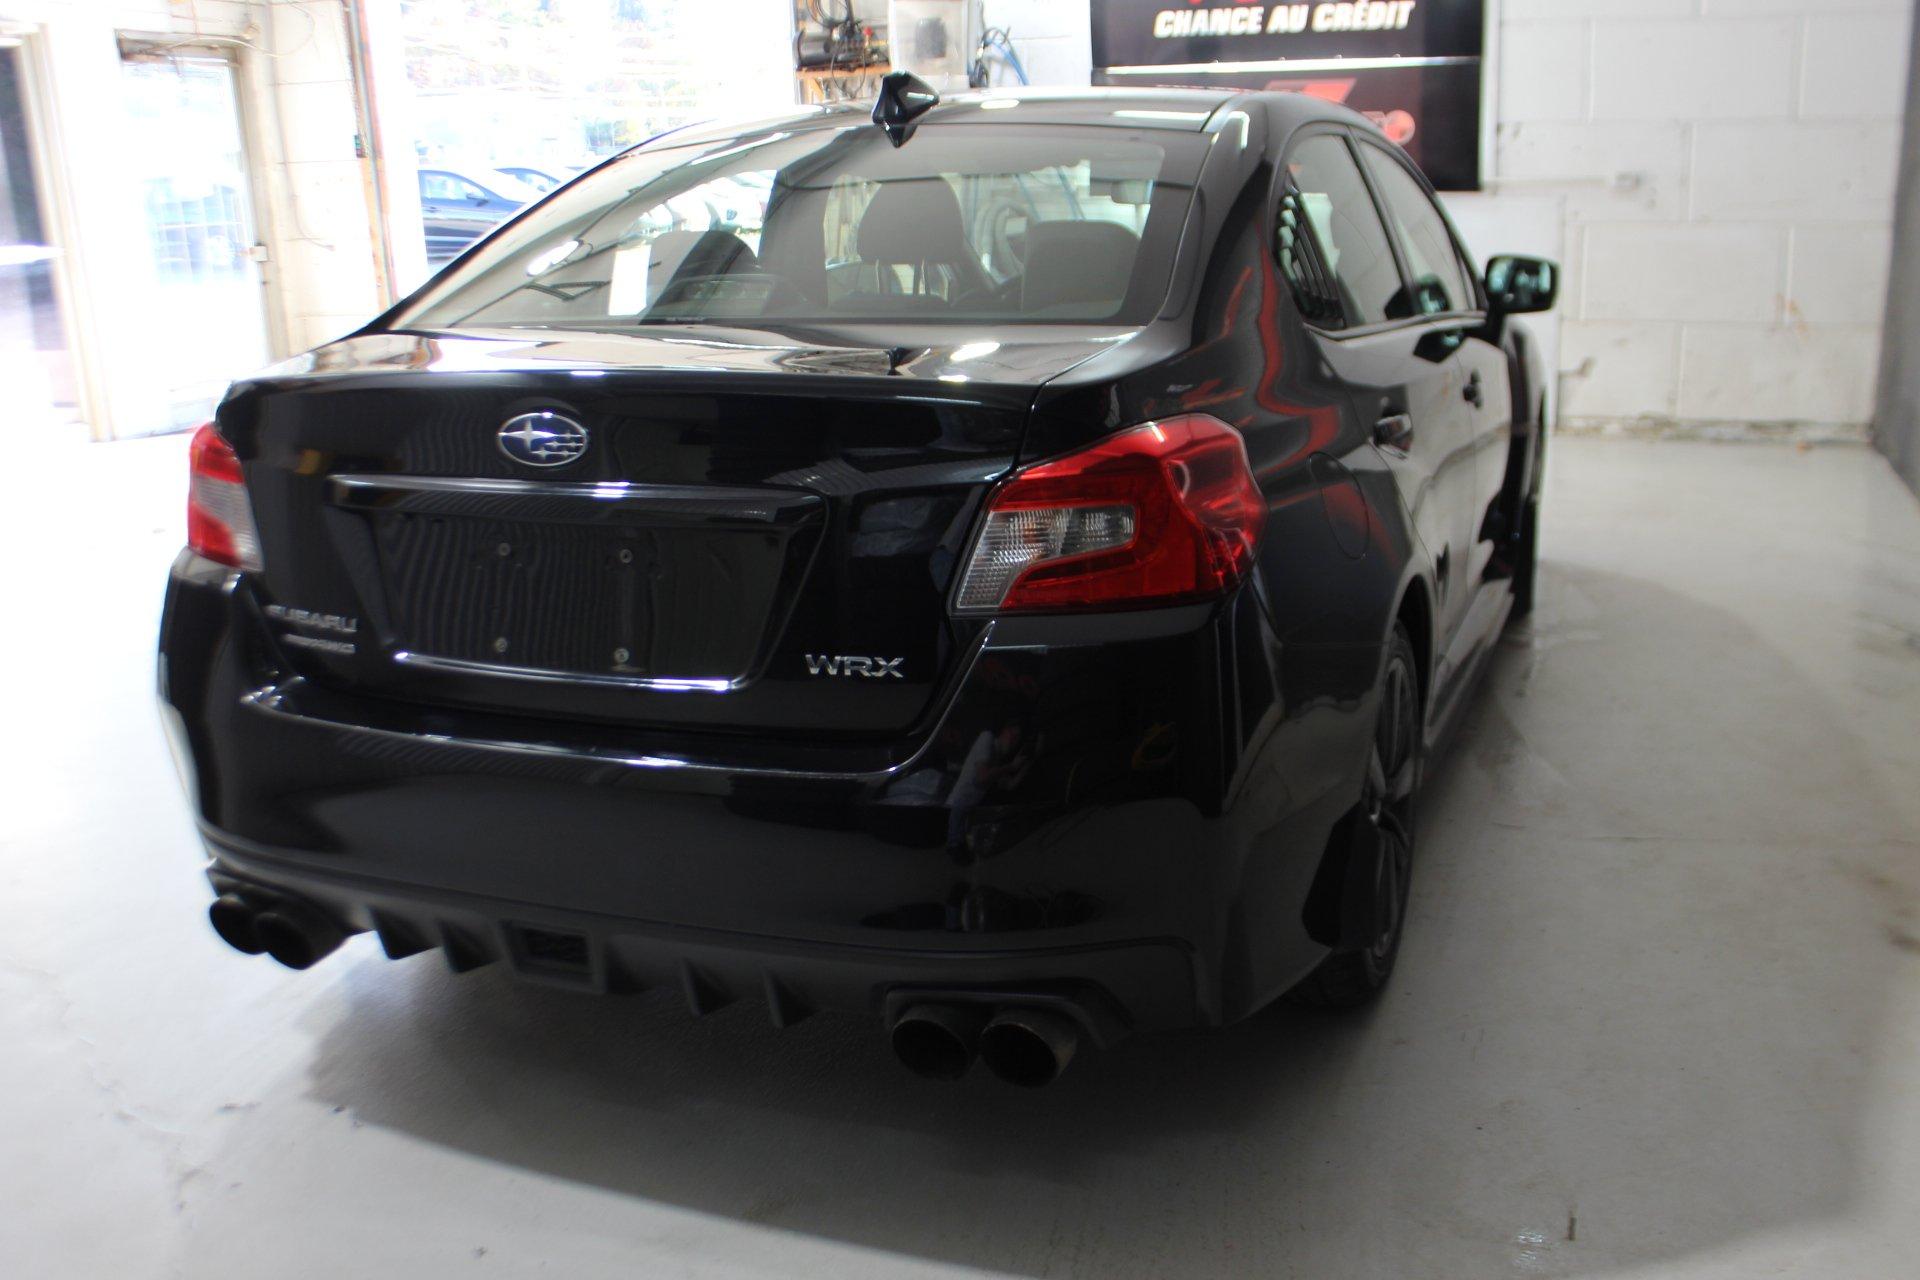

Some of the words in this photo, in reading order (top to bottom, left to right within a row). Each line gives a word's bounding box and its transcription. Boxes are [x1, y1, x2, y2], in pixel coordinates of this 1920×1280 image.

[1153, 7, 1263, 38] CHANCE
[1266, 4, 1311, 33] AU
[1311, 0, 1416, 32] CRÉDIT
[805, 653, 904, 678] WRX
